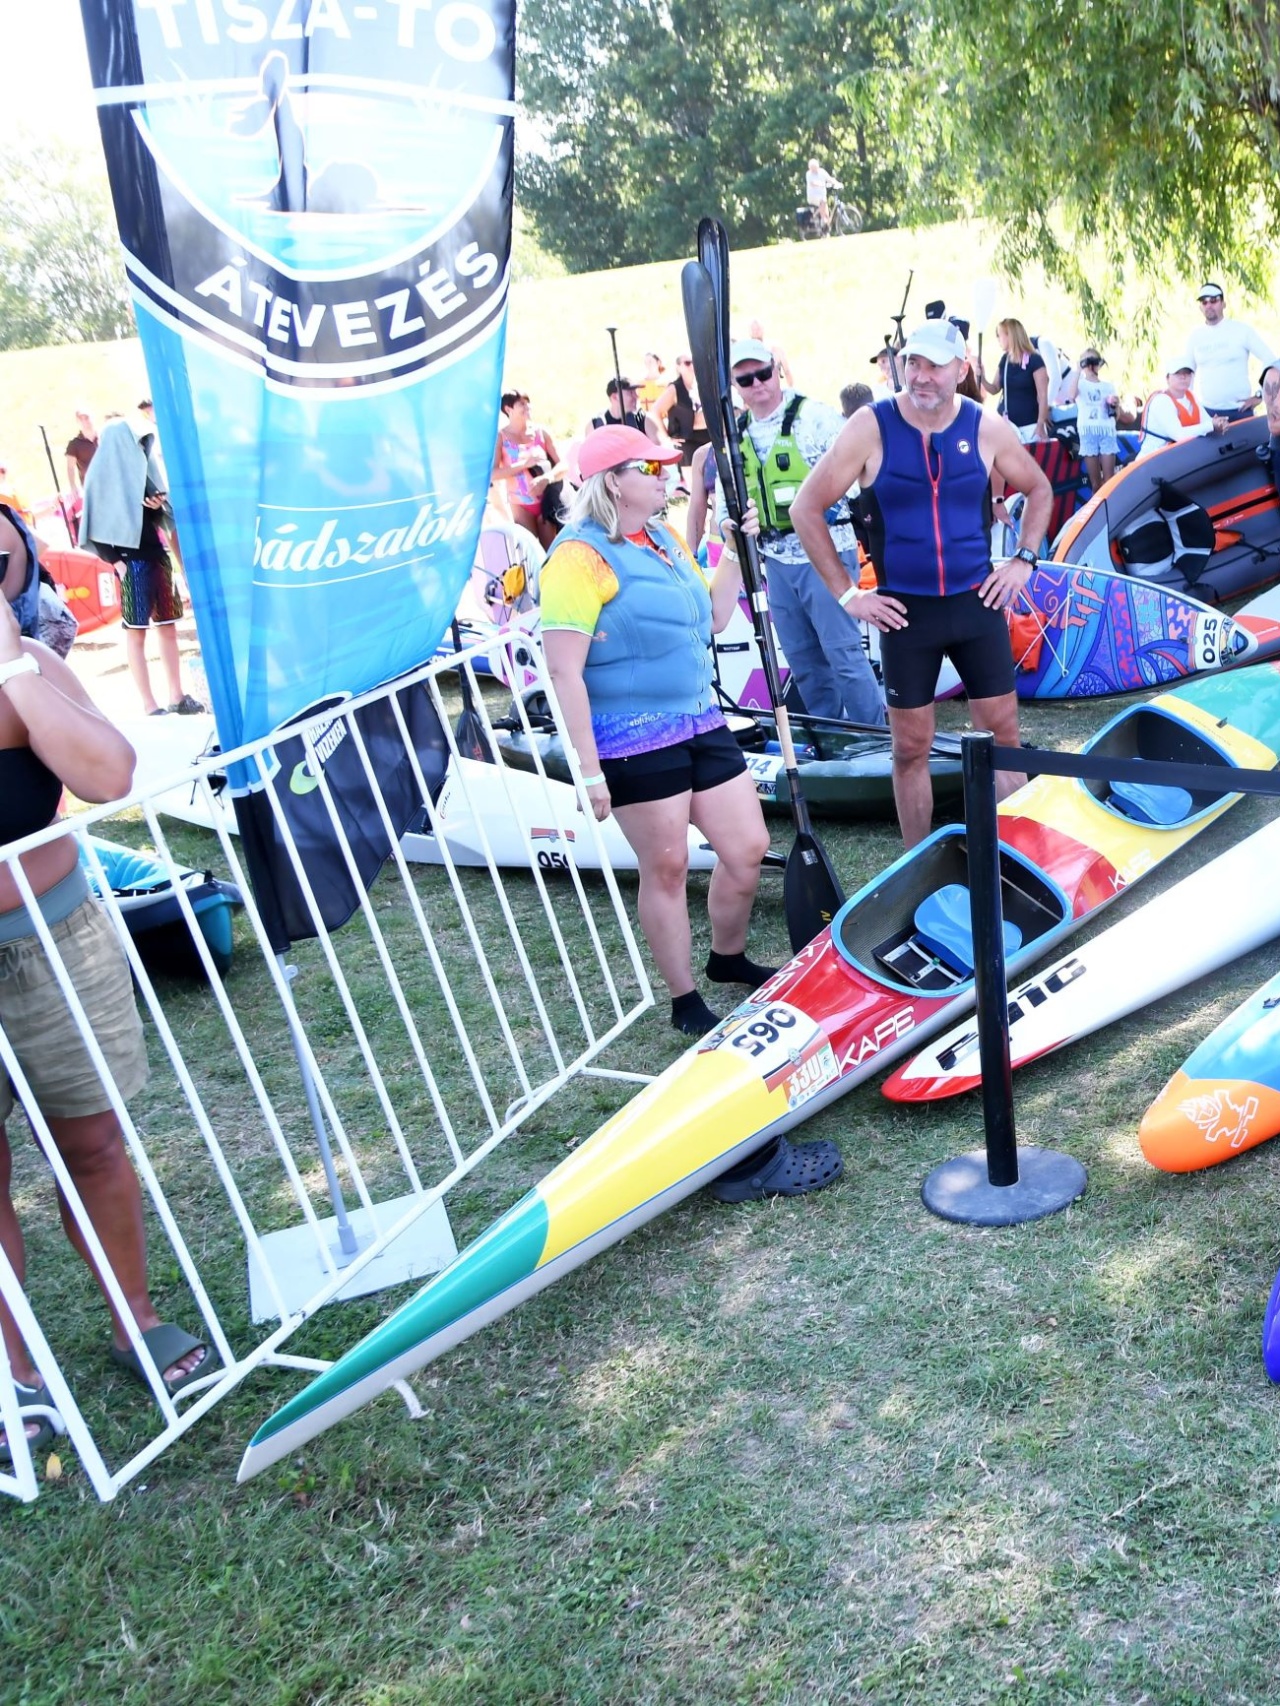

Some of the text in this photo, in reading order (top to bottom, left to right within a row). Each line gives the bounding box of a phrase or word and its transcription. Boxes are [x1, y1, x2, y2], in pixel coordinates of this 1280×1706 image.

[194, 241, 499, 348] ÁTEVEZÉS
[1202, 618, 1218, 664] 025
[731, 1008, 797, 1058] 065
[838, 1005, 916, 1078] KAPE
